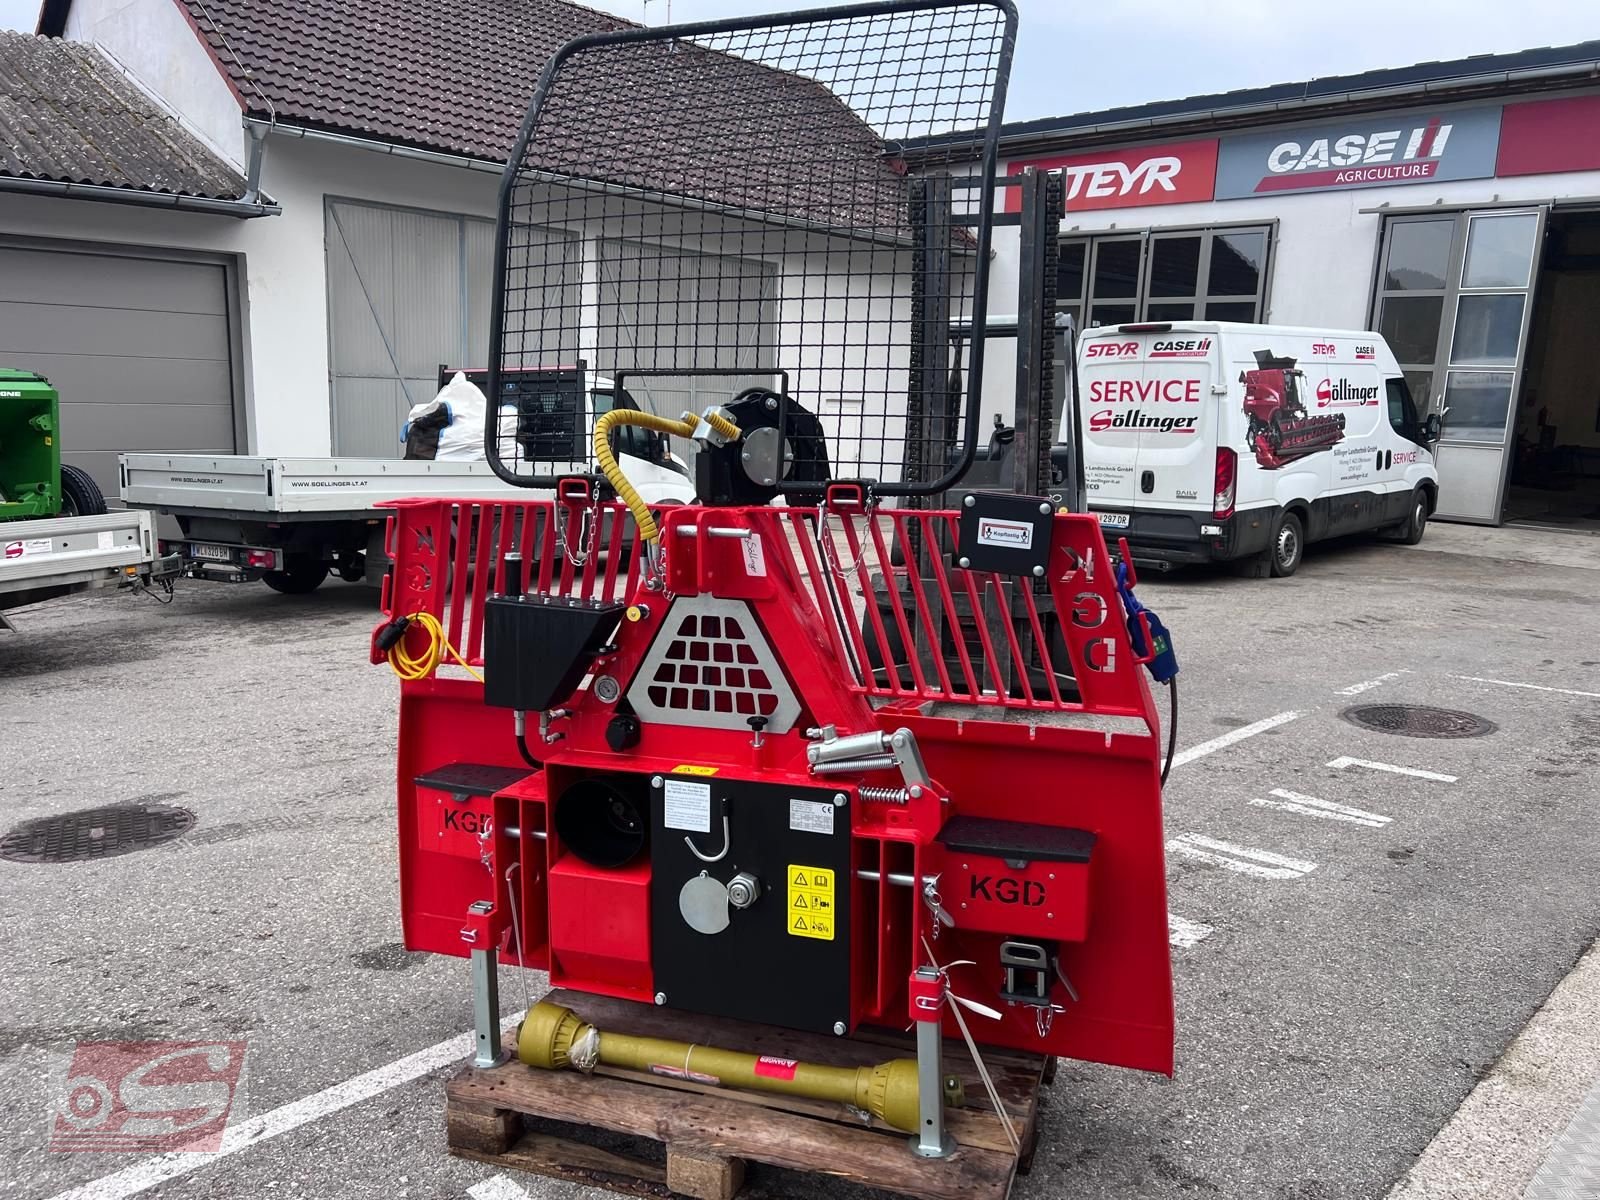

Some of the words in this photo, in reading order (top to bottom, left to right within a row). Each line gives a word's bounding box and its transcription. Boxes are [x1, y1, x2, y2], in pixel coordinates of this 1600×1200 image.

[1267, 132, 1399, 174] CASE
[1048, 156, 1182, 200] TEYR
[1335, 164, 1430, 183] AGRICULTURE
[1085, 342, 1139, 357] STEYR
[1153, 341, 1196, 351] CASE
[1312, 343, 1336, 355] STEYR
[1355, 345, 1369, 354] CASE
[1089, 379, 1201, 402] SERVICE
[1316, 378, 1379, 408] Söllinger
[1089, 409, 1198, 433] Söllinger
[1393, 451, 1417, 464] SERVICE
[1103, 514, 1116, 524] 297
[1117, 515, 1127, 525] DR
[444, 807, 492, 834] KGD
[970, 874, 1046, 907] KGD
